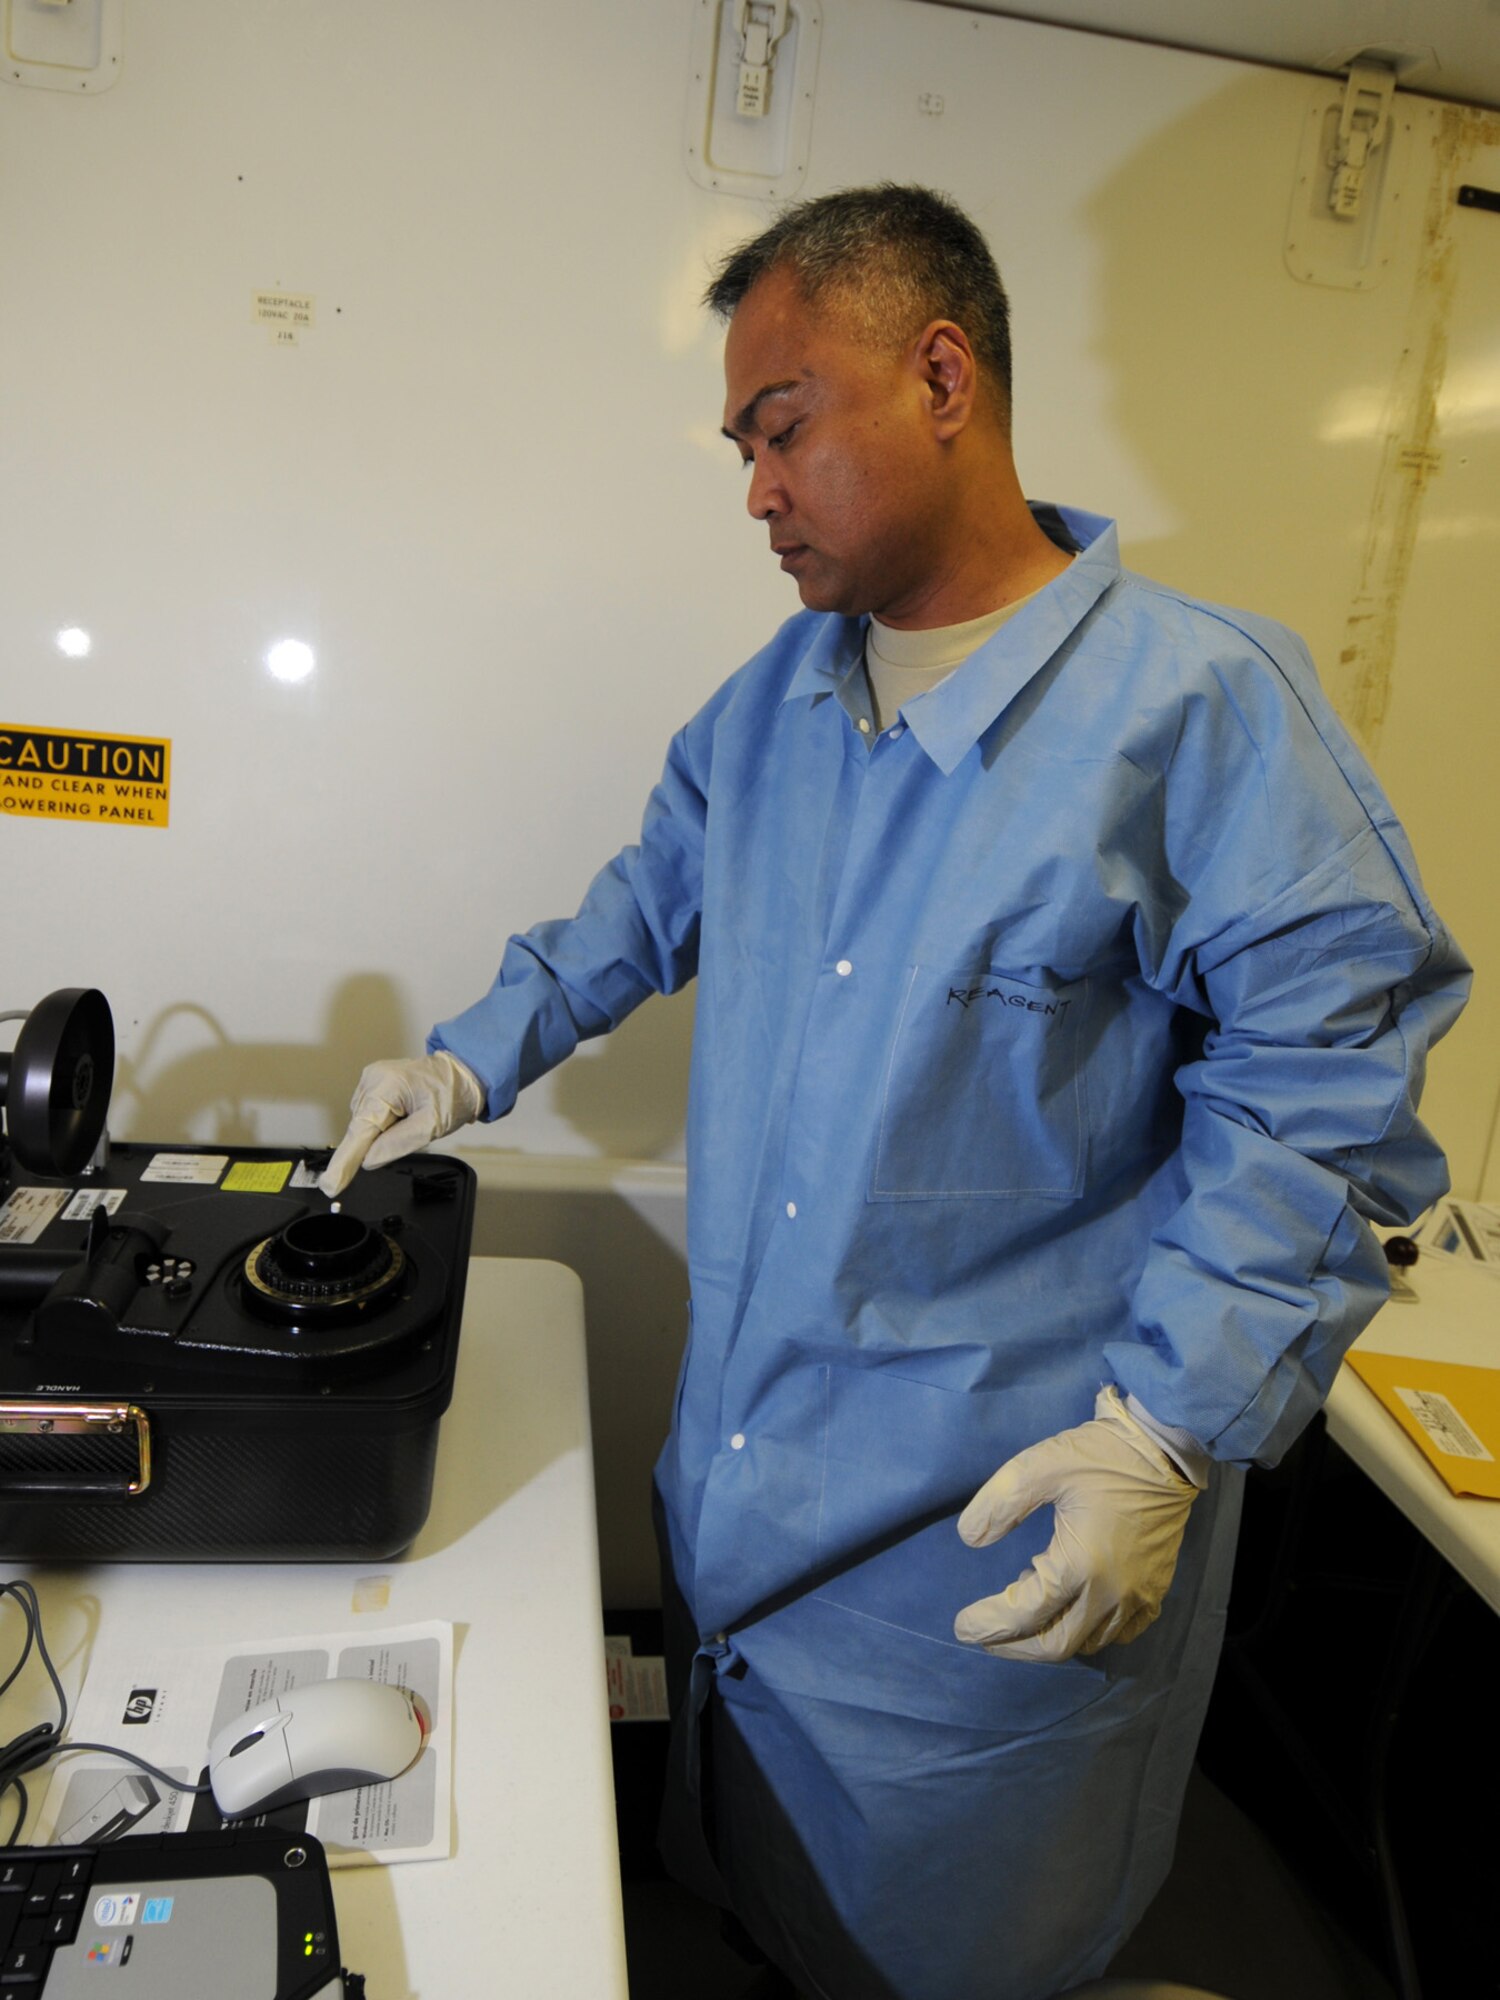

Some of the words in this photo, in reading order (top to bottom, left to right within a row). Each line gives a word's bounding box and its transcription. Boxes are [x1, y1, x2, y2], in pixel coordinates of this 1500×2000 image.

[258, 296, 310, 309] RECEPTACLE
[0, 736, 160, 778] CAUTION
[0, 776, 43, 789] AND
[51, 779, 105, 795] CLEAR
[114, 785, 167, 800] WHEN
[0, 797, 91, 815] OWERING
[99, 805, 155, 821] PANEL
[946, 987, 1072, 1025] REAGENT
[167, 1791, 179, 1807] 450
[352, 1817, 359, 1825] de
[14, 1954, 26, 1968] Del
